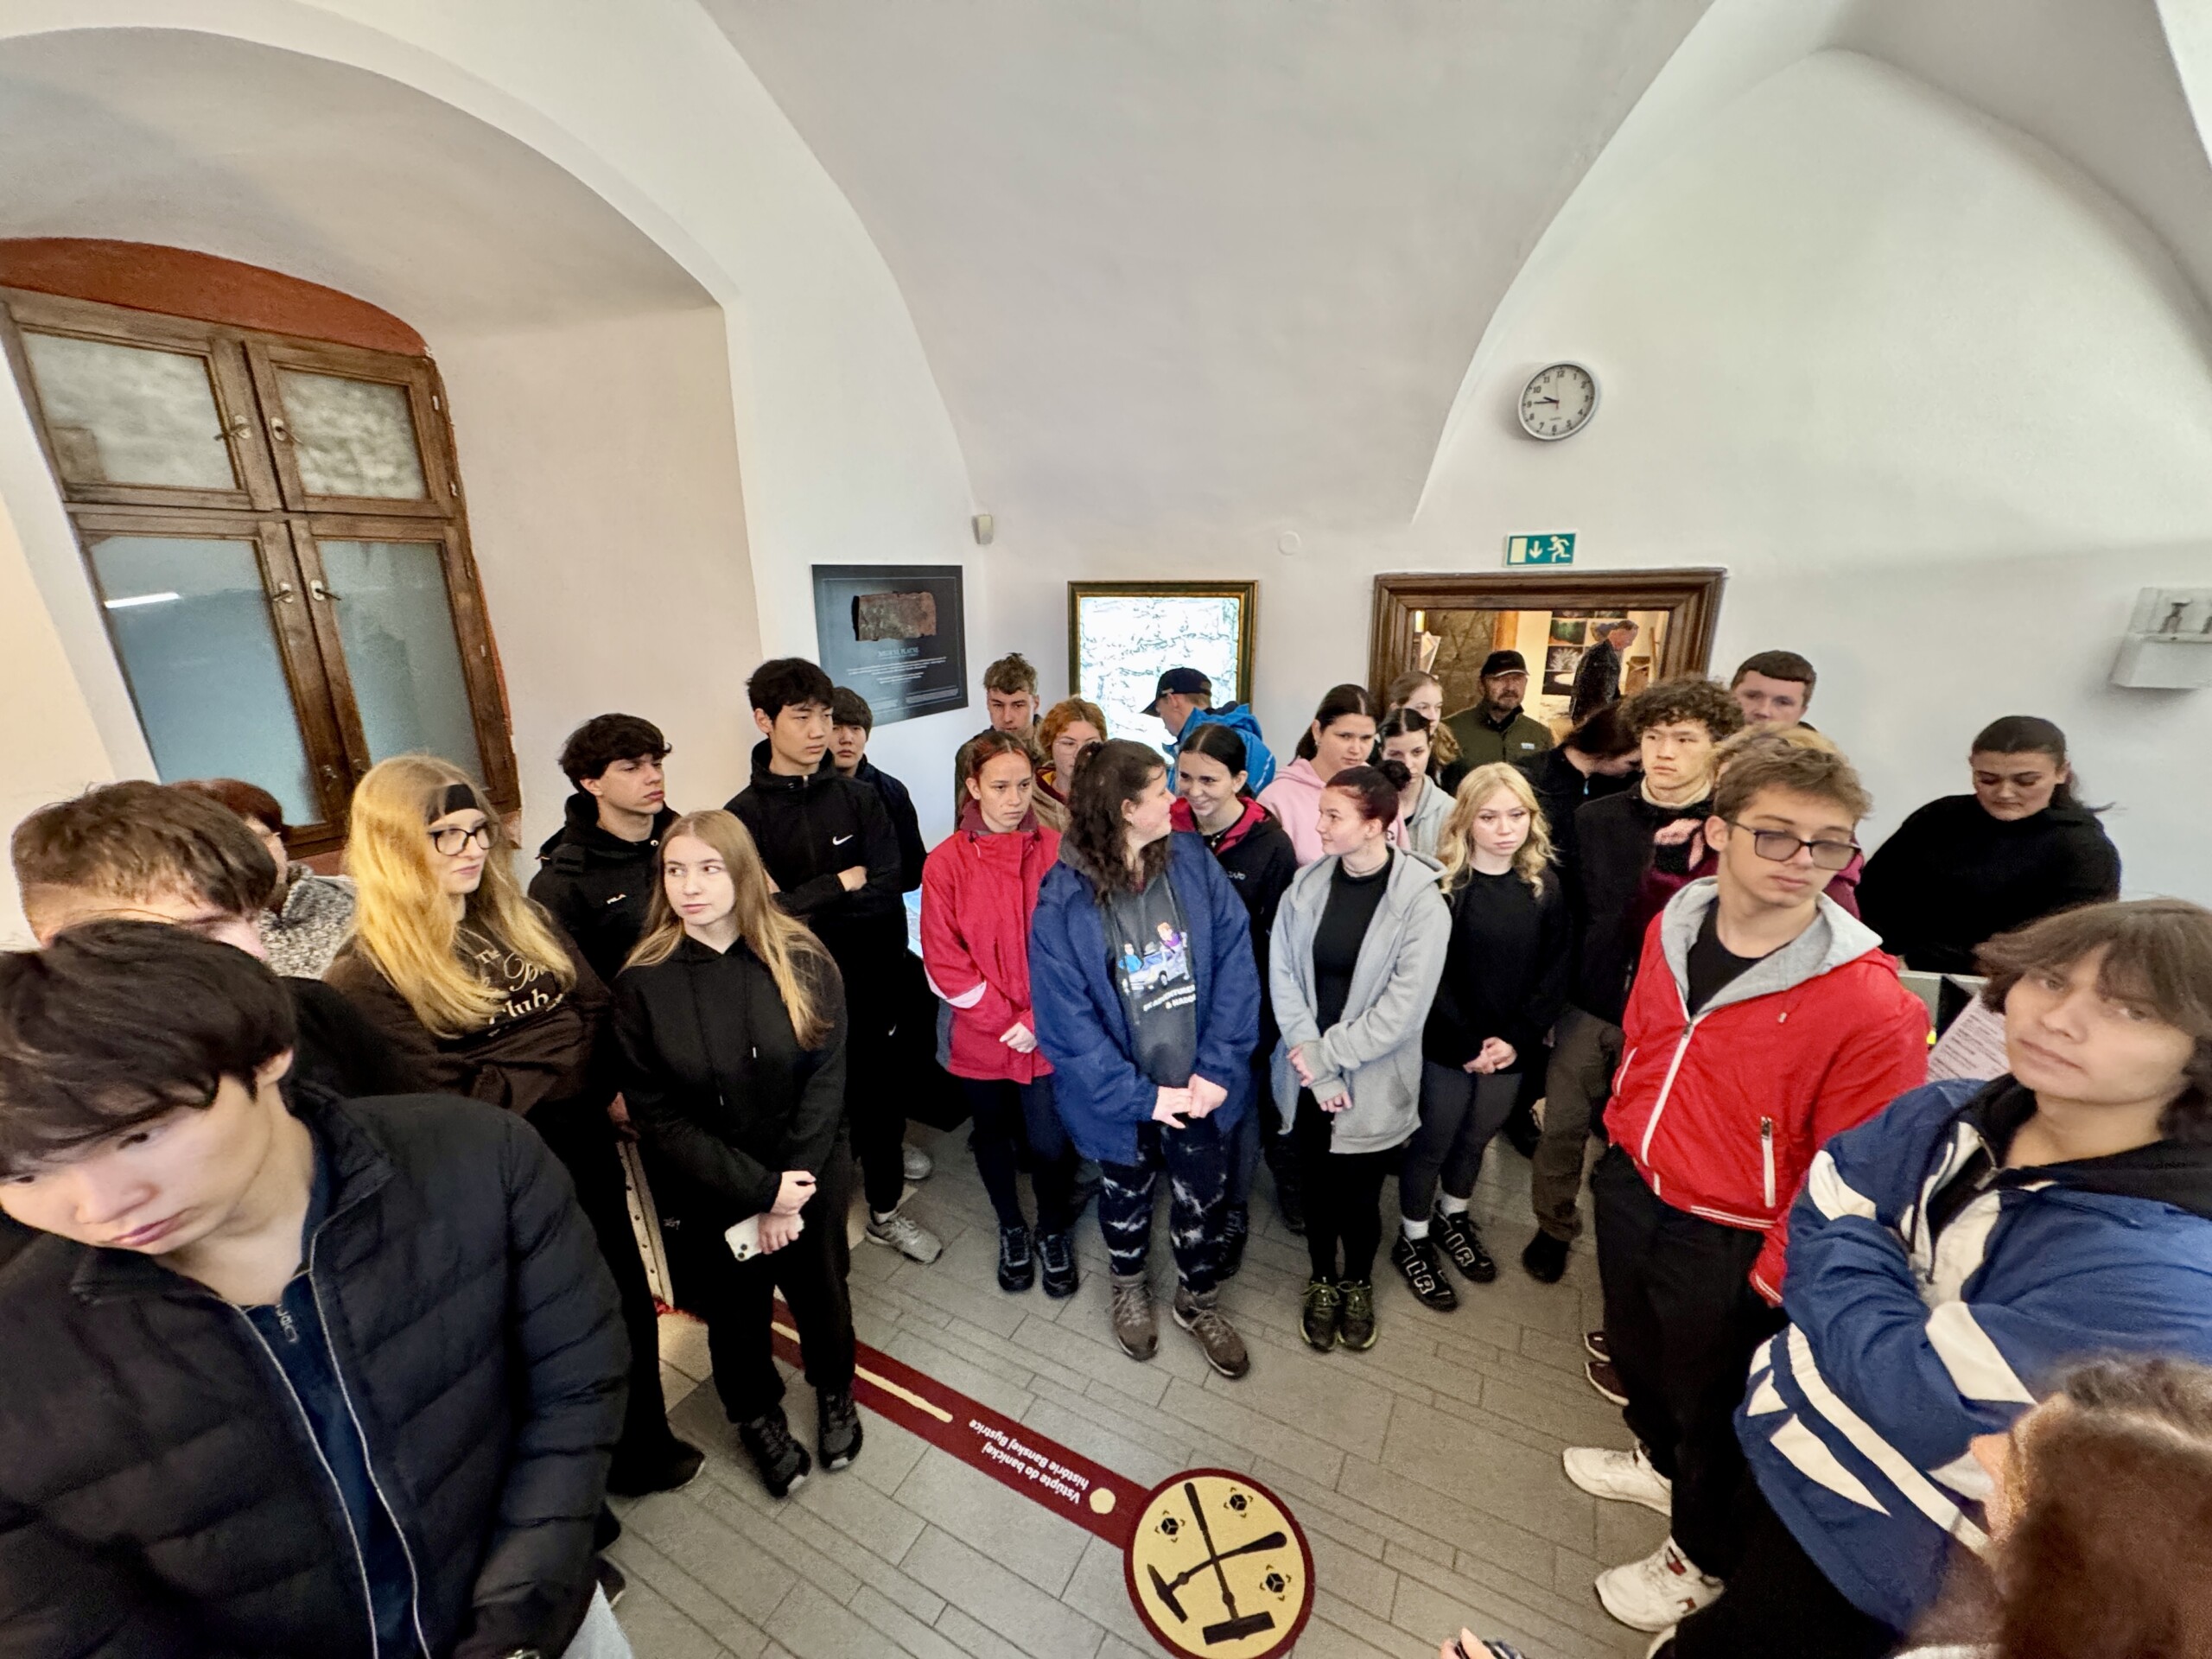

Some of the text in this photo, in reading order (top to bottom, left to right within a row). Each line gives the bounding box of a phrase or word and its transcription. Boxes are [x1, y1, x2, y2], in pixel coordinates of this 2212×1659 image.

[1556, 370, 1565, 378] 12
[488, 988, 550, 1026] lub
[969, 1419, 1090, 1491] histórie Banskej Bystrice
[1025, 1466, 1039, 1479] do
[1039, 1473, 1080, 1503] Vstúpte
